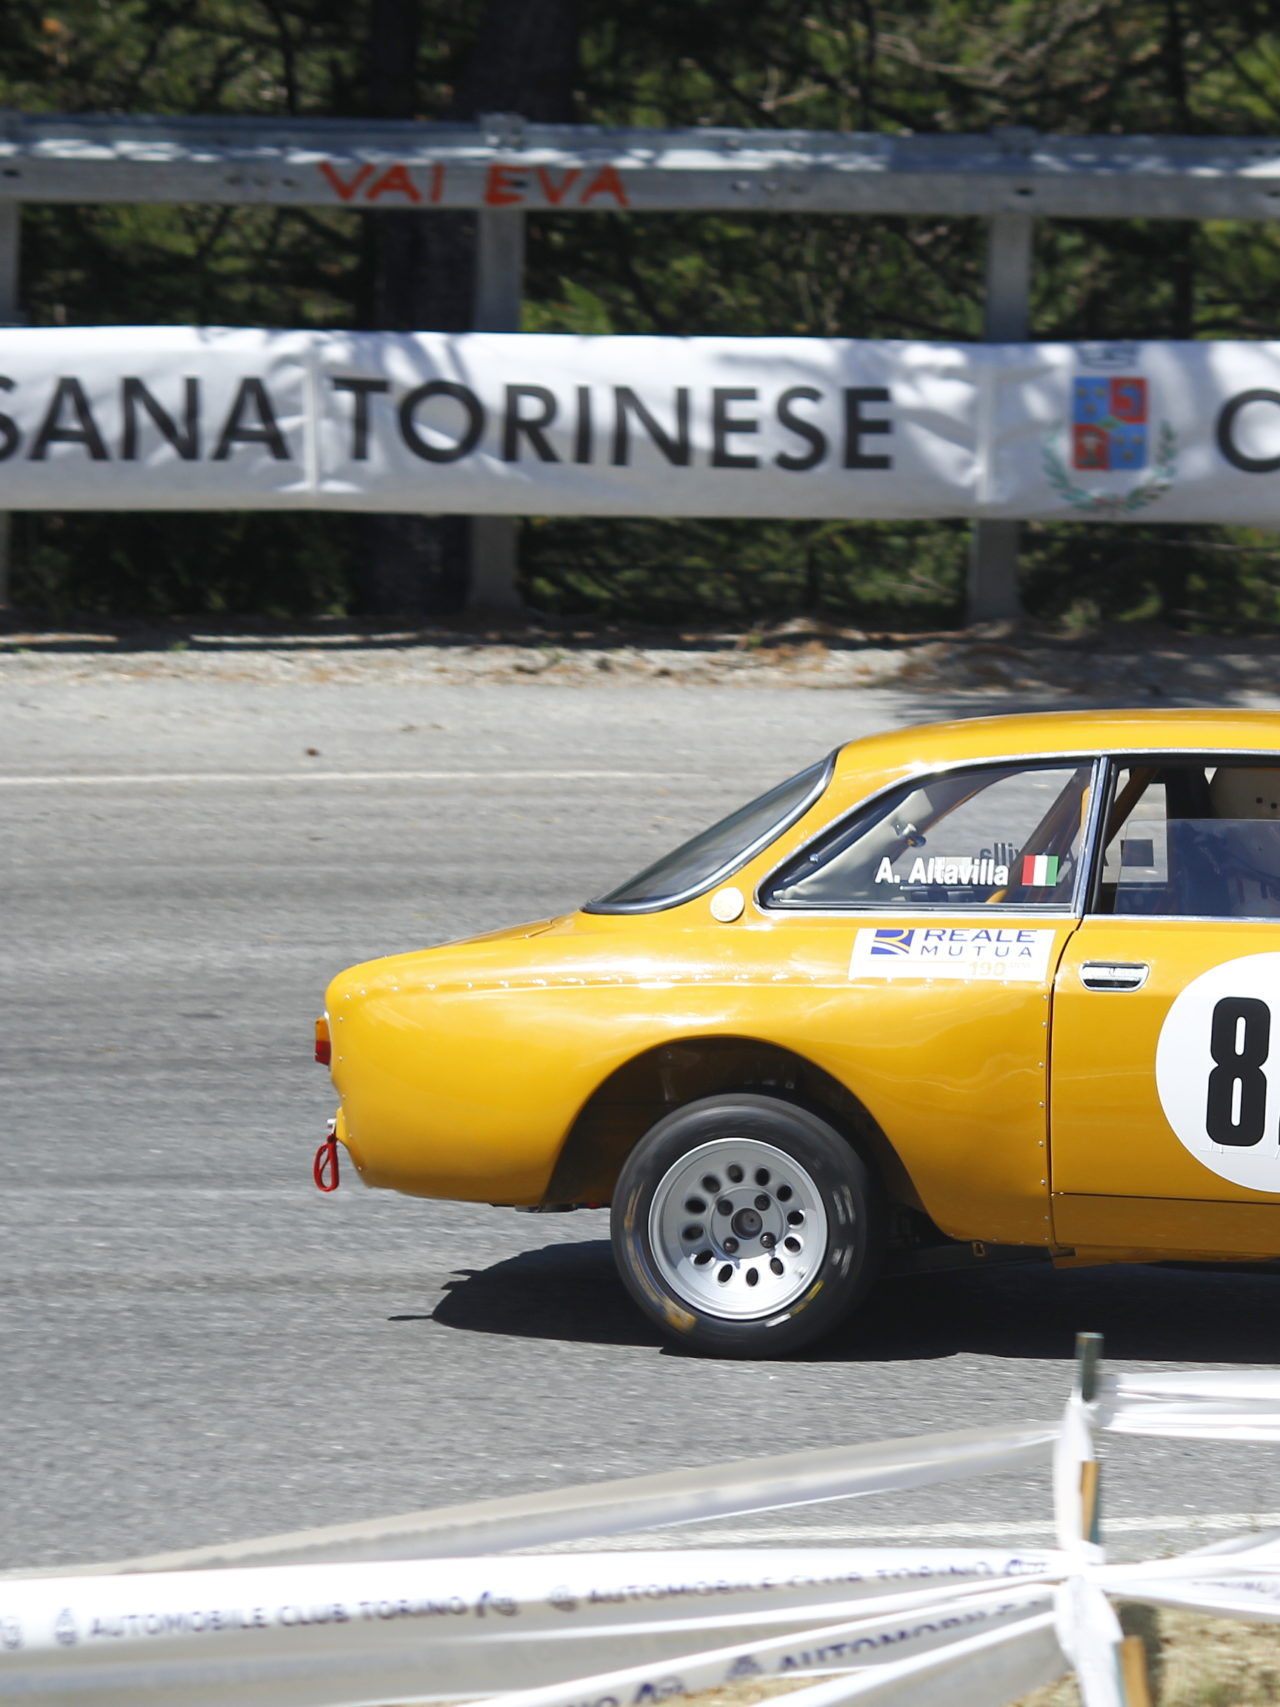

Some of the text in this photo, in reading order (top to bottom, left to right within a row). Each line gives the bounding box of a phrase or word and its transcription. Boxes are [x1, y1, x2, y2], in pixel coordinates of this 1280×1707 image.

[317, 160, 629, 208] VAI EVA
[331, 378, 894, 471] TORINESE
[874, 856, 1010, 887] A. Altavilla
[923, 928, 1038, 944] REALE
[920, 945, 1033, 958] MUTUA
[278, 1603, 350, 1627] CLUB
